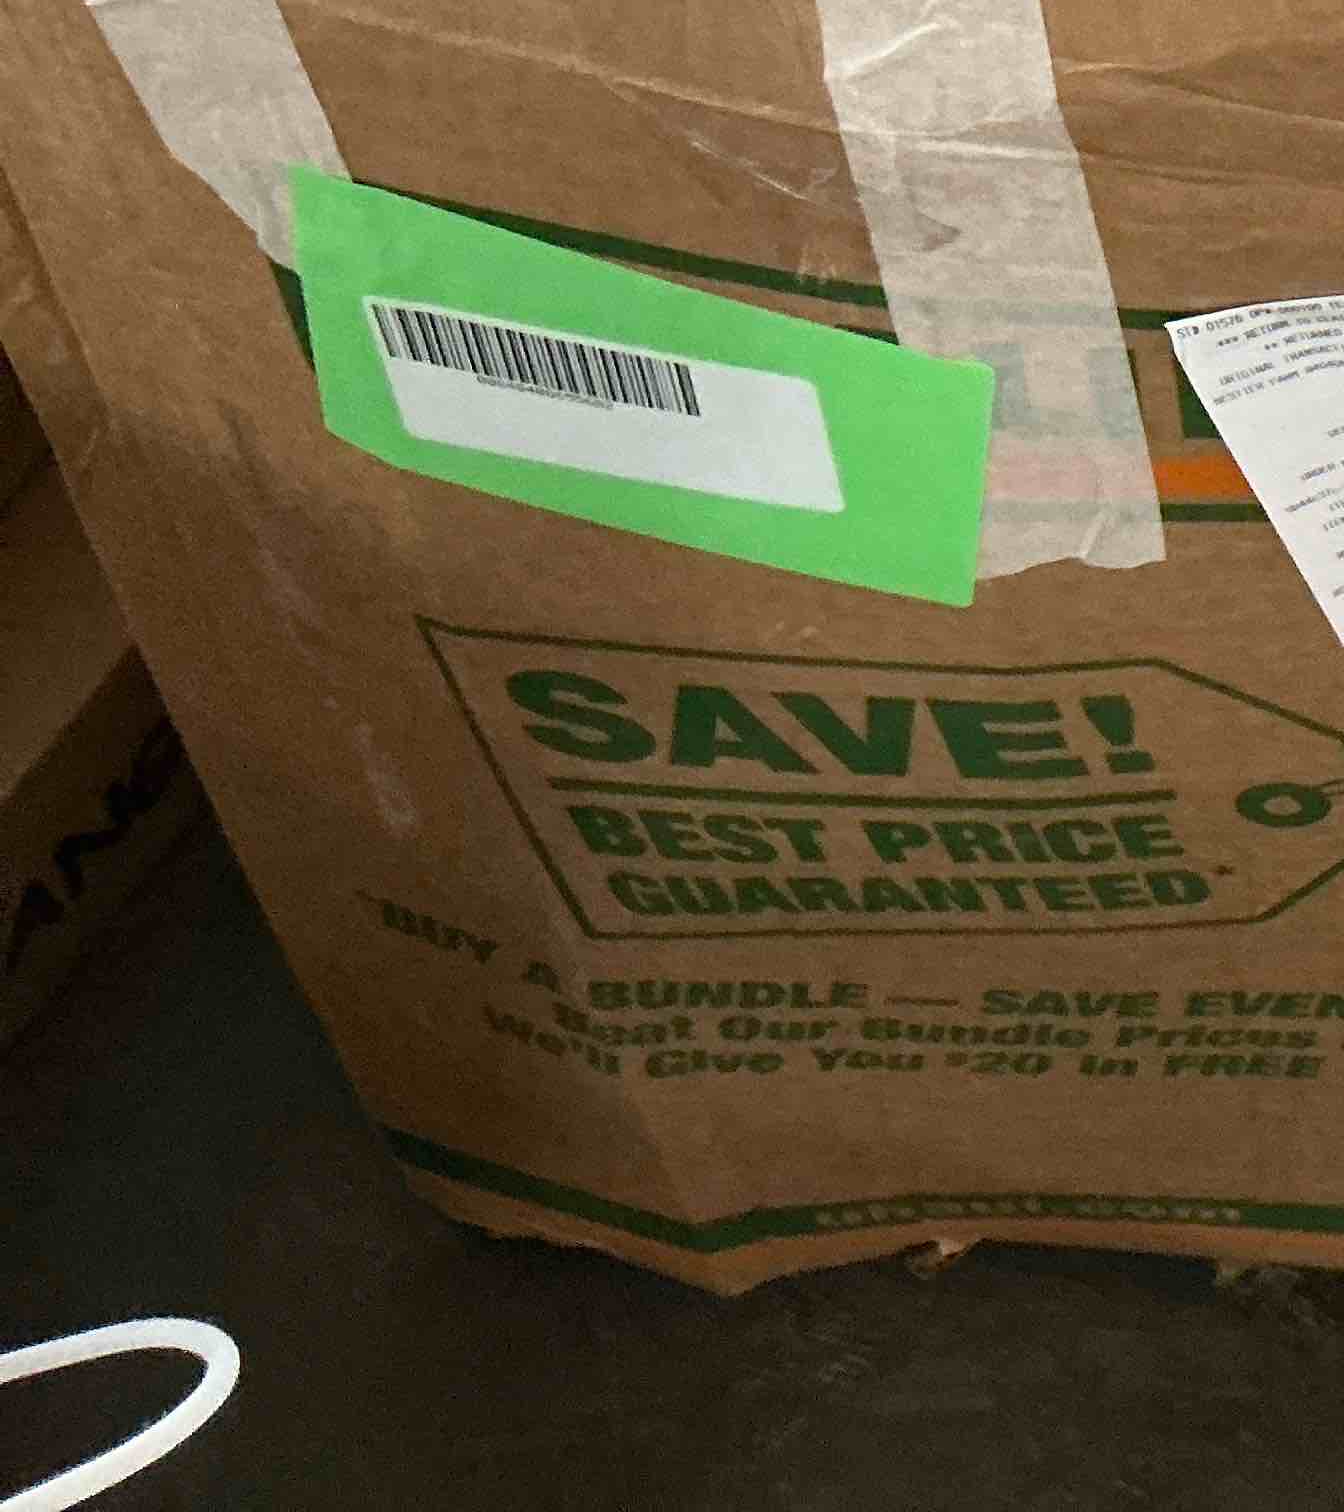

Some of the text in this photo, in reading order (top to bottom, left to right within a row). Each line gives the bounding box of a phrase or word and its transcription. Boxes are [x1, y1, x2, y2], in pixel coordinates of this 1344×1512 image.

[504, 669, 1157, 784] SAVE!
[563, 803, 1186, 867] BEST PRICE
[586, 980, 870, 1010] BUNDLE
[980, 988, 1161, 1019] SAVE
[718, 1015, 839, 1042] Our
[860, 1017, 1091, 1050] Bundle
[1115, 1024, 1319, 1051] Prices
[644, 1048, 786, 1079] Give
[811, 1047, 927, 1073] You
[1163, 1052, 1328, 1080] FREE
